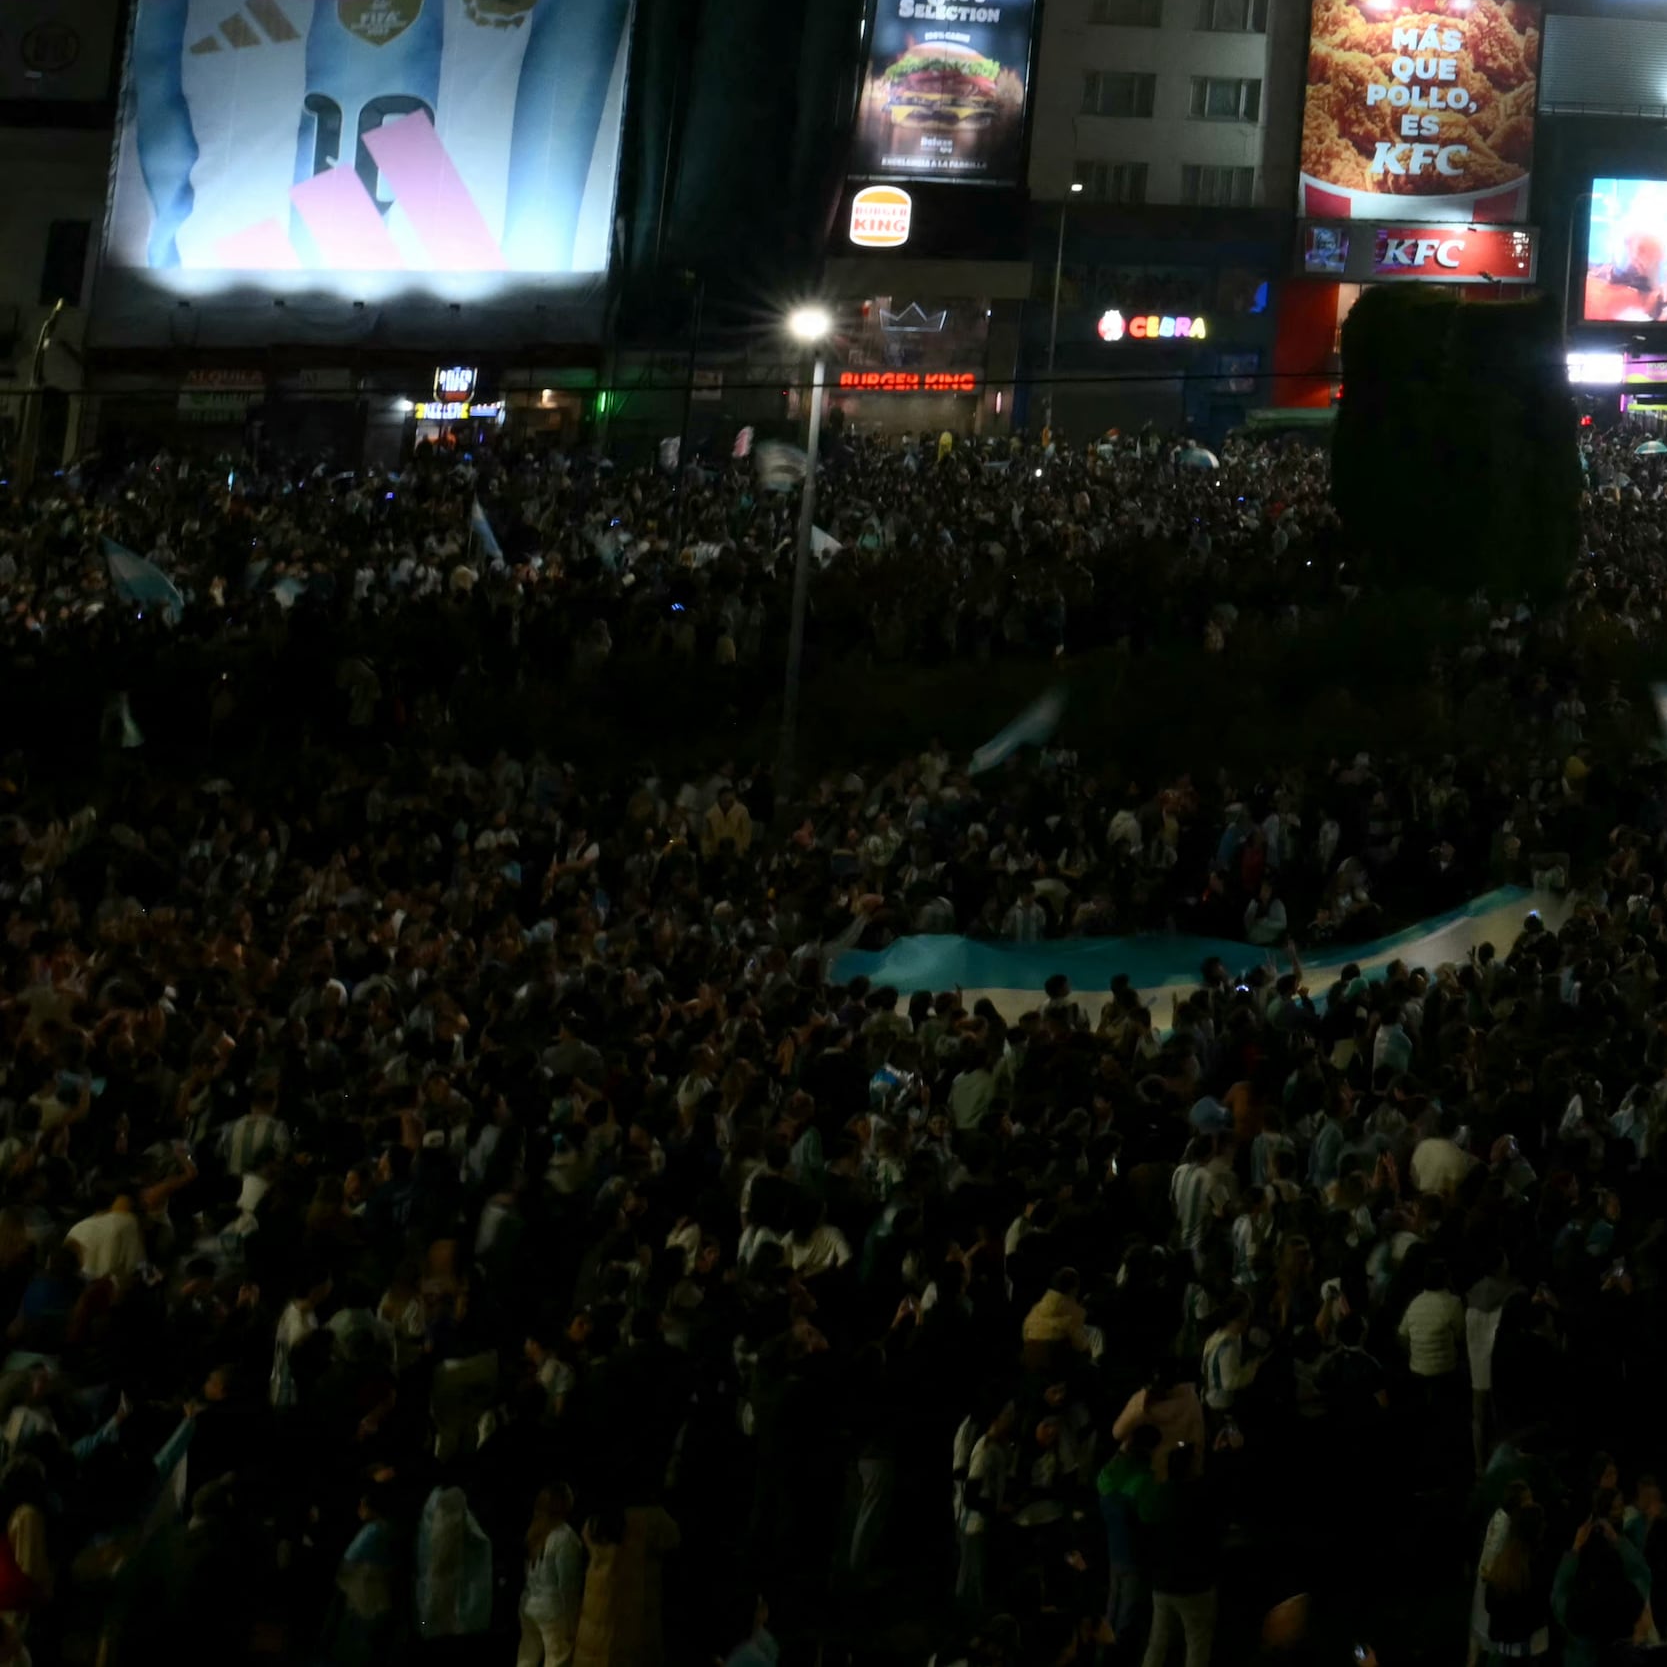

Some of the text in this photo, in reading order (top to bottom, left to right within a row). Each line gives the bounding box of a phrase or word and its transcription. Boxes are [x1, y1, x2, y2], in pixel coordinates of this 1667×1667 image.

[1392, 23, 1462, 52] MÁS
[1392, 55, 1457, 82] QUE
[1367, 85, 1477, 113] POLLO,
[1401, 114, 1440, 136] ES
[1370, 142, 1469, 176] KFC
[855, 206, 908, 217] BURGER
[853, 218, 906, 232] KING
[1381, 239, 1465, 268] KFC
[1129, 316, 1206, 339] CEBRA
[840, 372, 976, 392] BURGER KING
